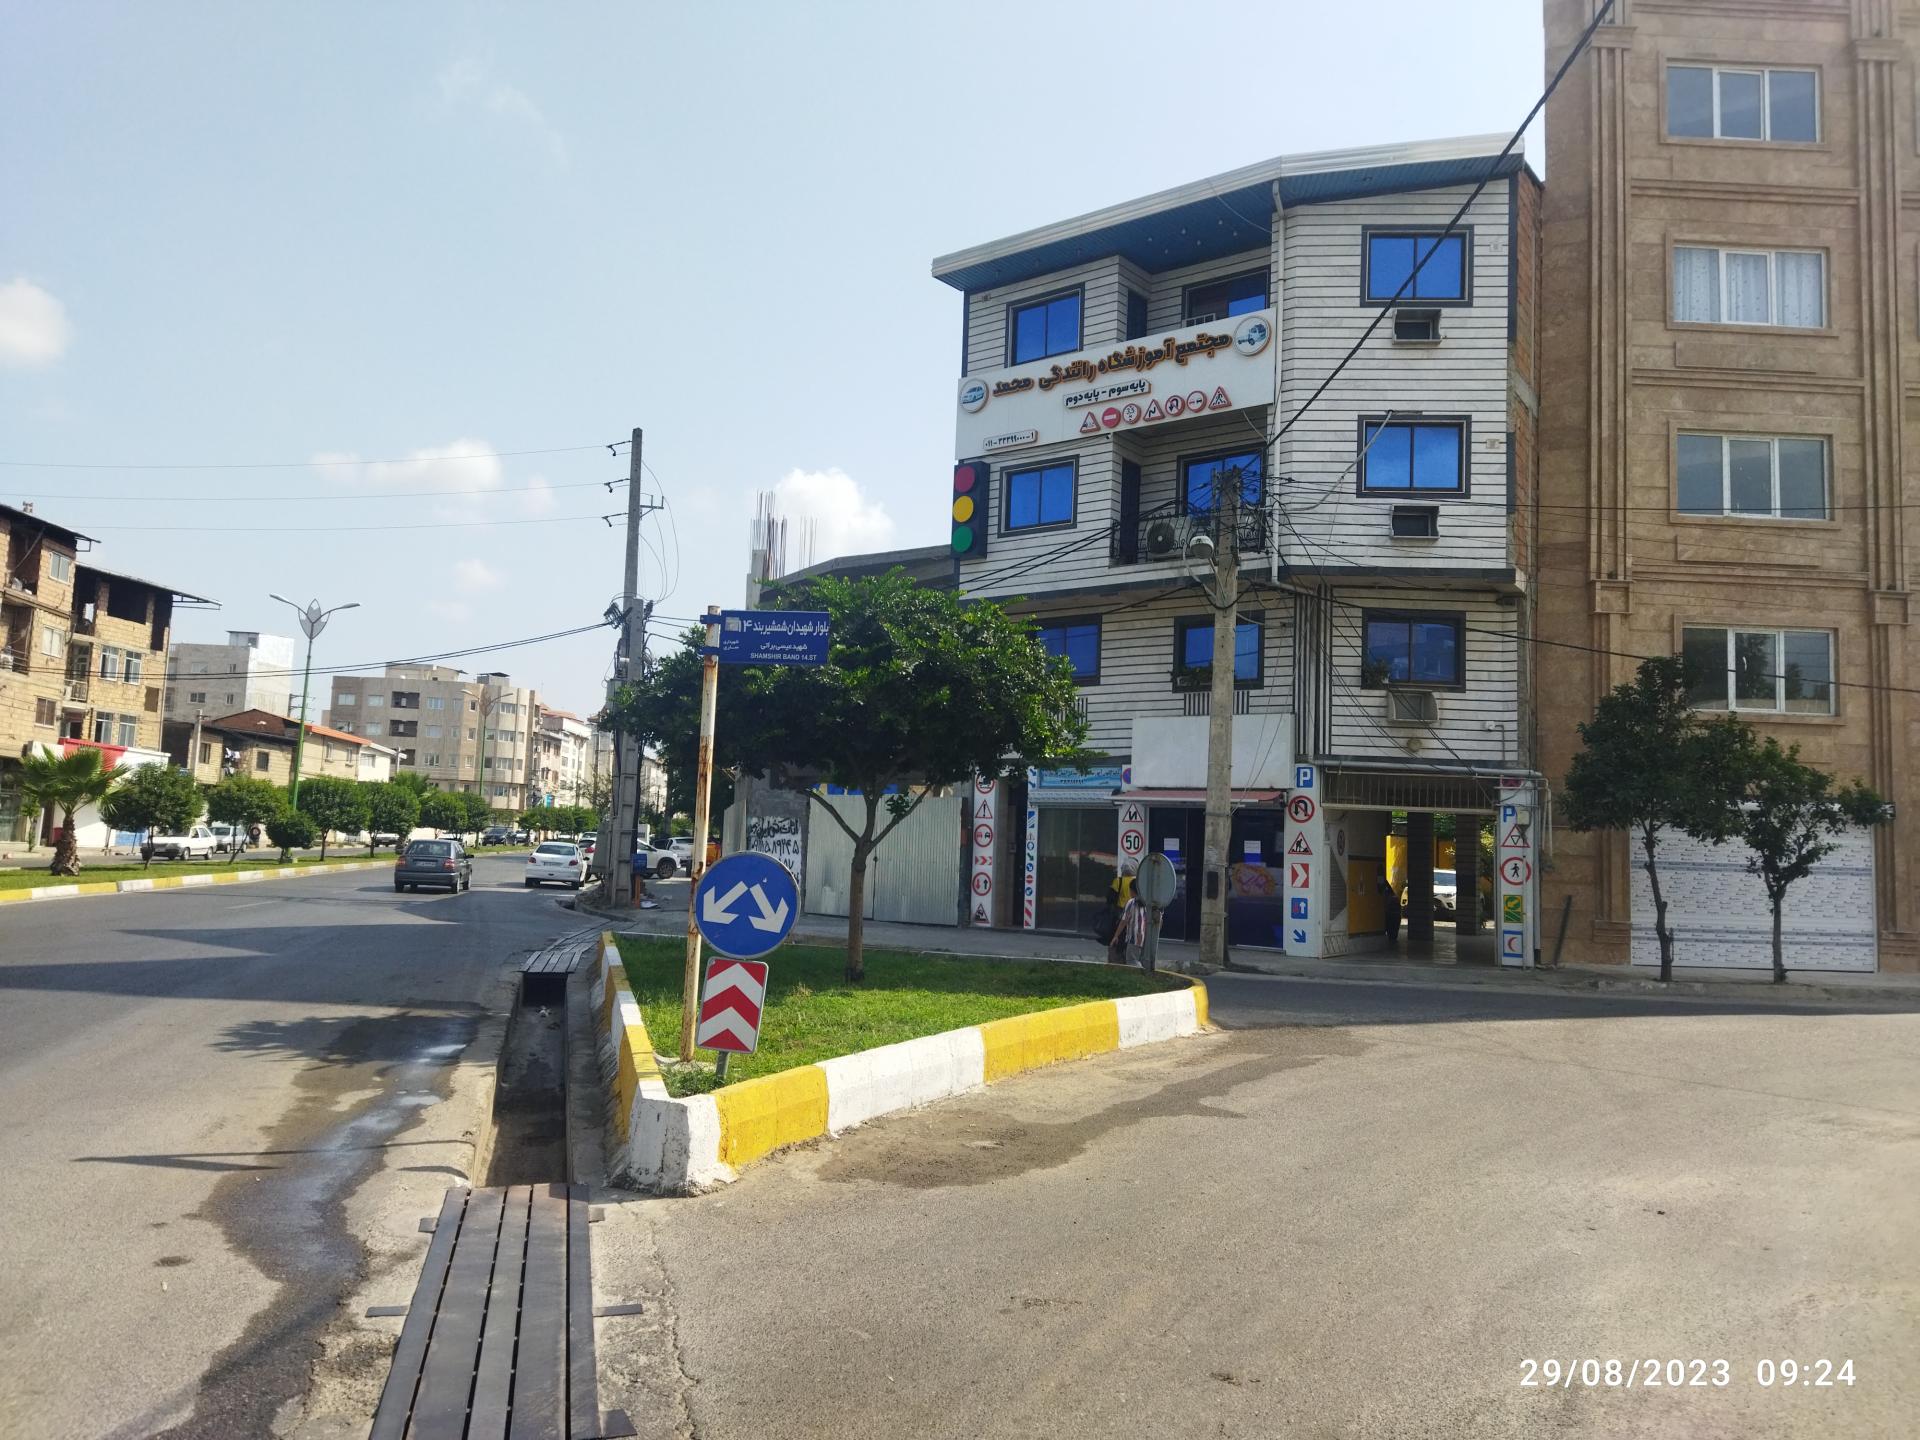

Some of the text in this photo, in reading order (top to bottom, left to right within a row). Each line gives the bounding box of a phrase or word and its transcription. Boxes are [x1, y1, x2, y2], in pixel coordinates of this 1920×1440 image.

[1097, 336, 1176, 374] آموزشگاه
[1175, 331, 1233, 366] مجتمع
[1038, 359, 1098, 391] رانندگی
[1108, 386, 1130, 398] سوم
[1130, 379, 1146, 393] پایه
[1065, 394, 1084, 406] دوم
[1083, 388, 1100, 402] پایه
[787, 620, 814, 636] شهیدان
[813, 620, 829, 636] بلوار
[793, 643, 808, 652] شهید
[750, 652, 782, 660] SHAMSHIR
[1300, 768, 1311, 787] P
[1503, 805, 1516, 823] P
[1125, 835, 1140, 850] 50
